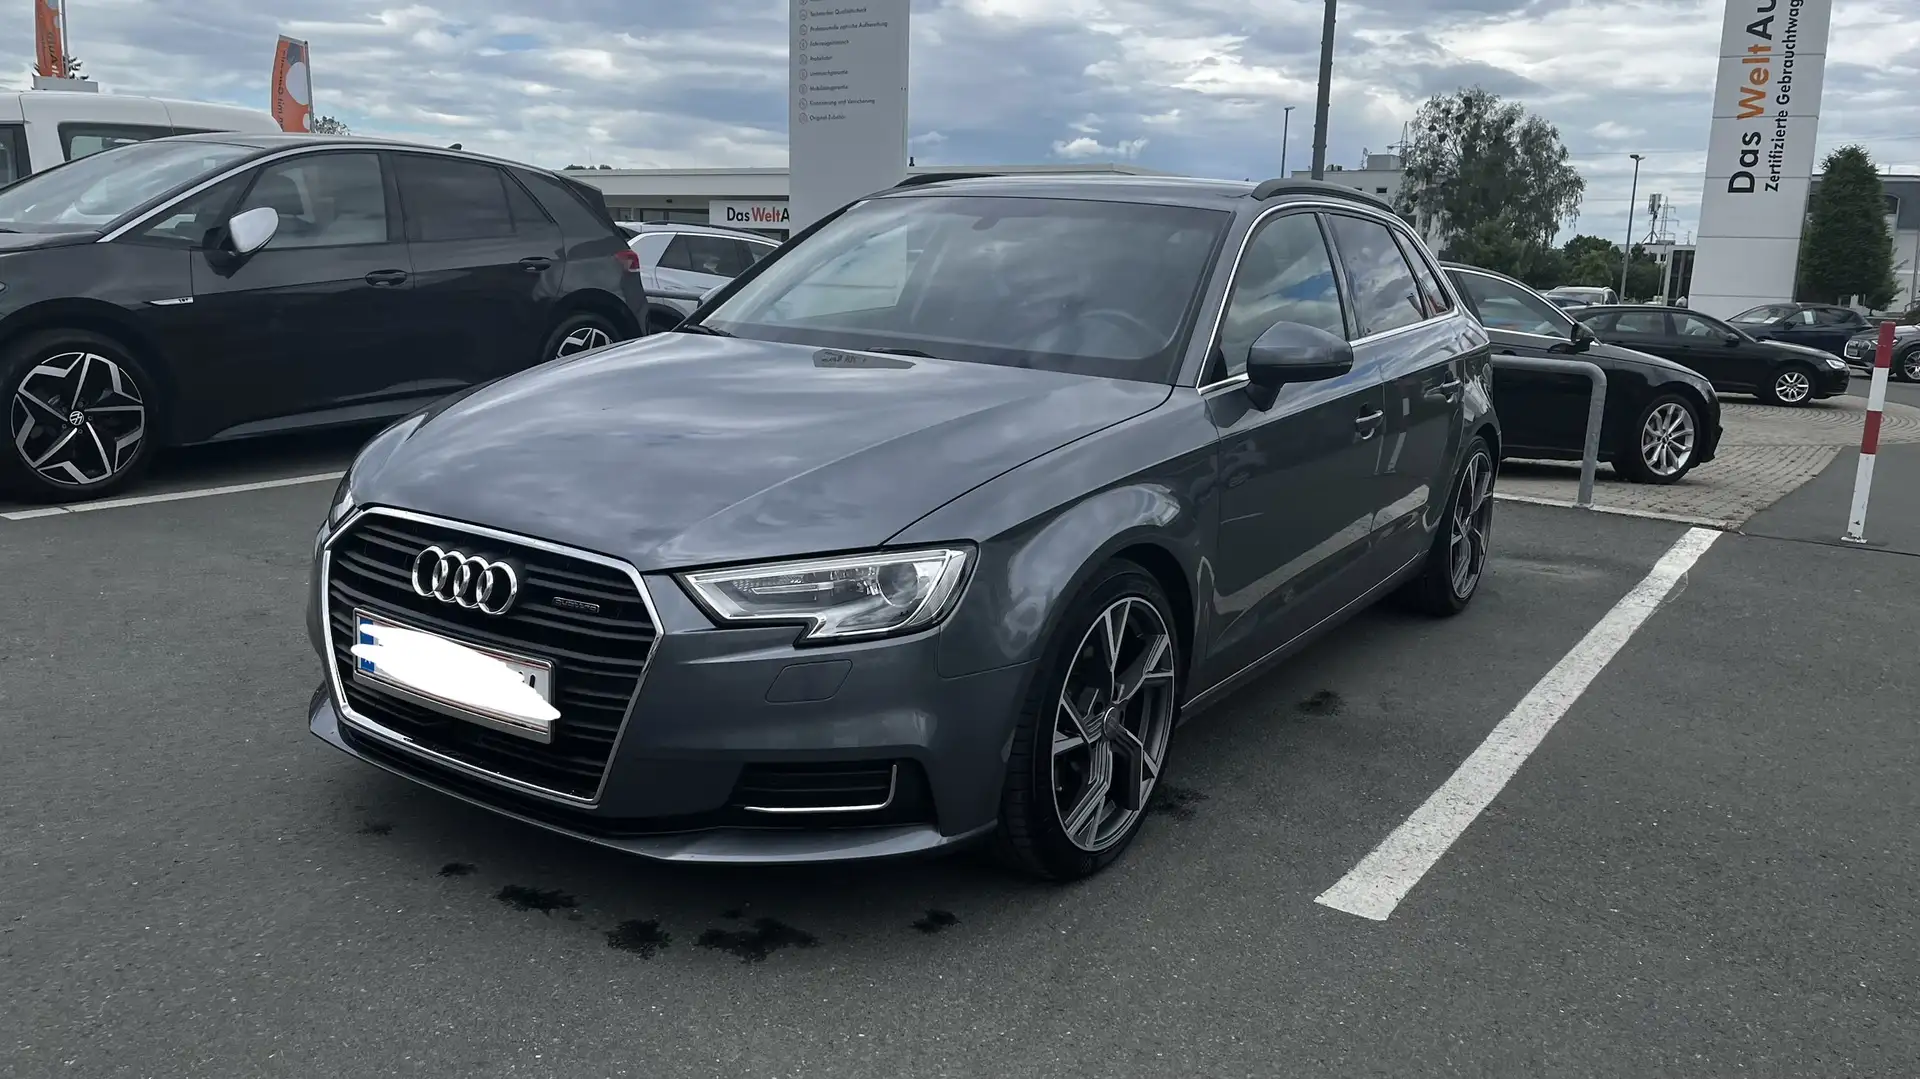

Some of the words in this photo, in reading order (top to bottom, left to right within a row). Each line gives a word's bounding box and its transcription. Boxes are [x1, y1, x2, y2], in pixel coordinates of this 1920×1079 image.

[1727, 131, 1762, 194] Das
[1765, 110, 1788, 192] Zertifizierte
[726, 206, 750, 222] Das
